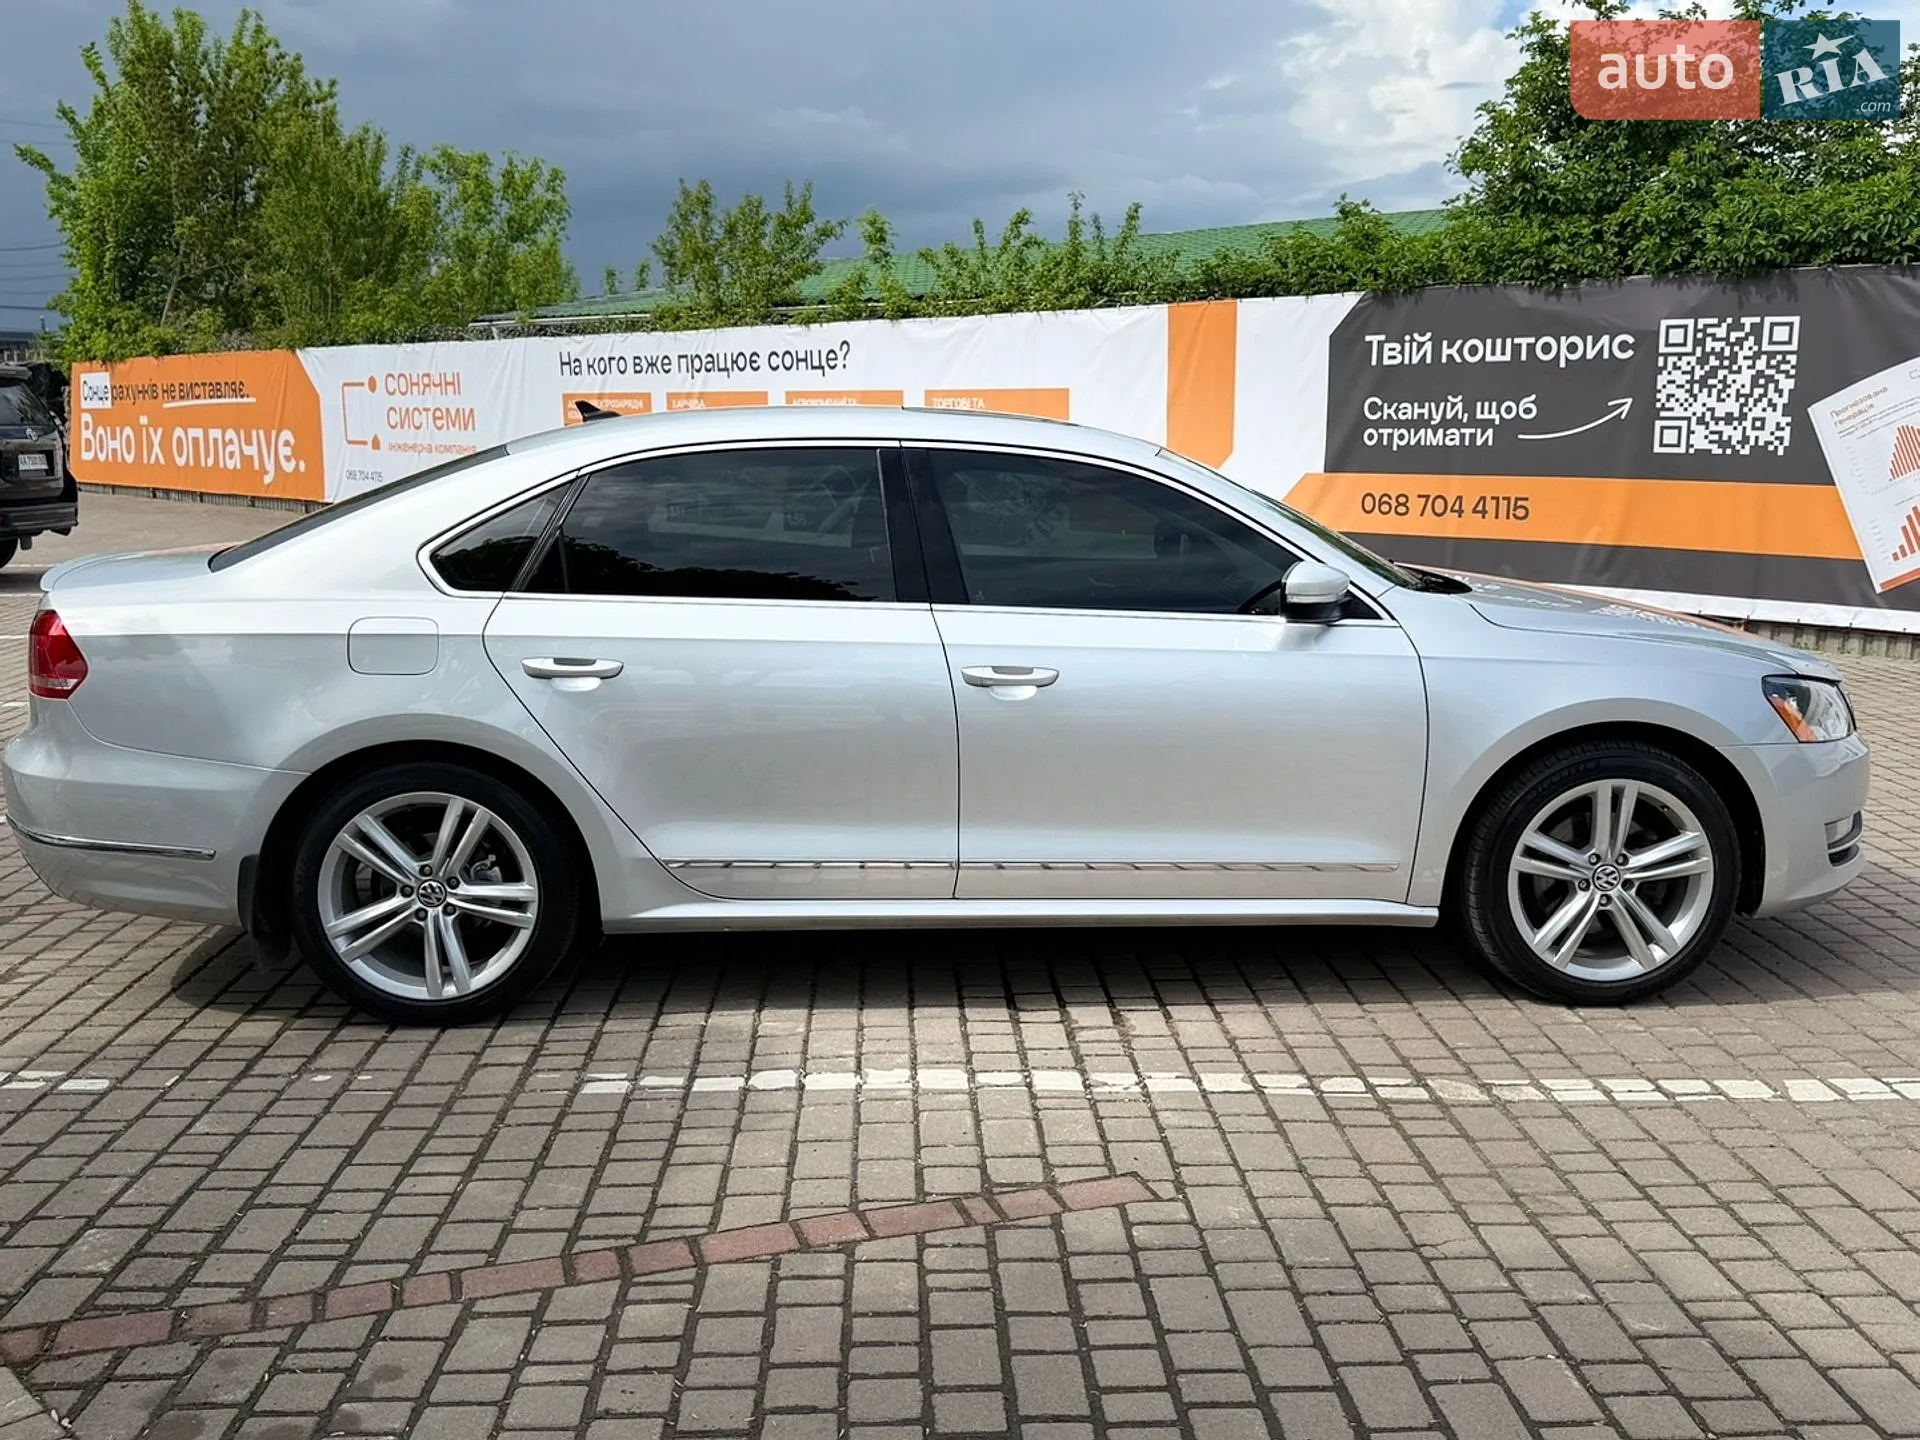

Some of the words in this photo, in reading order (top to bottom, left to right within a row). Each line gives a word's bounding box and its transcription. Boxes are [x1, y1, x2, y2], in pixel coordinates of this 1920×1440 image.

[558, 351, 583, 376] На
[586, 355, 628, 376] кого
[632, 354, 672, 375] вже
[677, 350, 761, 379] працює
[767, 340, 851, 377] сонце?
[1364, 332, 1433, 367] Твій
[1441, 332, 1636, 368] кошторис
[82, 380, 109, 405] Сонце
[111, 377, 158, 406] рахунків
[161, 383, 176, 400] не
[179, 381, 251, 400] виставляє.
[384, 372, 462, 396] СОНЯЧНІ
[1363, 394, 1469, 425] Скануй,
[1475, 394, 1538, 425] щоб
[80, 413, 136, 464] Воно
[139, 415, 165, 465] їх
[171, 427, 307, 485] оплачує.
[1363, 427, 1495, 451] отримати
[1361, 492, 1410, 517] 068
[1417, 494, 1465, 519] 704
[1471, 495, 1530, 521] 4115
